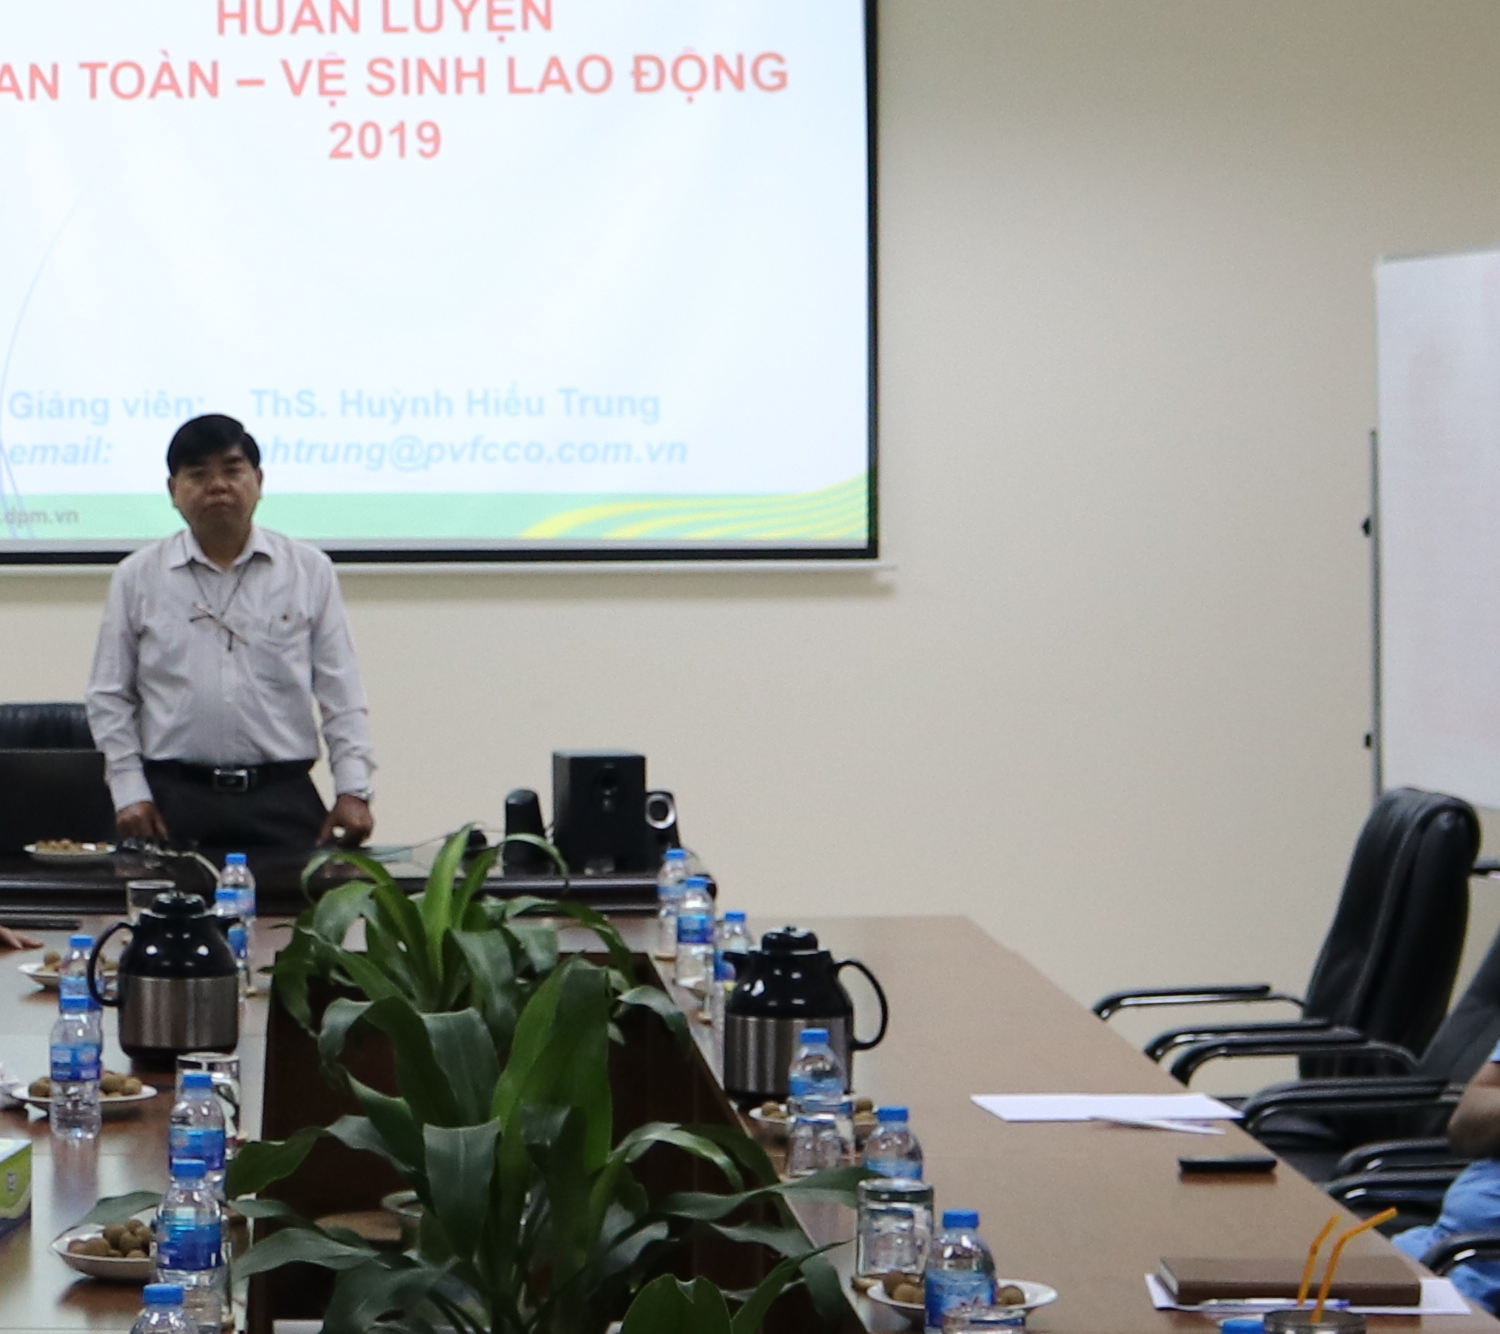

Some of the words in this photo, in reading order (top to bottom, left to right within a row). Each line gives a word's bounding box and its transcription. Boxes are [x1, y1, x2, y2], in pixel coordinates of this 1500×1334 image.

[78, 49, 220, 100] TOÀN
[280, 50, 347, 108] VỆ
[364, 55, 487, 97] SINH
[505, 53, 614, 95] LAO
[630, 46, 789, 104] ĐỘNG
[327, 119, 443, 161] 2019
[7, 389, 111, 427] Giảng
[250, 387, 327, 419] ThS.
[338, 387, 455, 425] Huỳnh
[465, 381, 545, 418] Hiếu
[557, 386, 662, 425] Trung
[7, 437, 114, 466] email:
